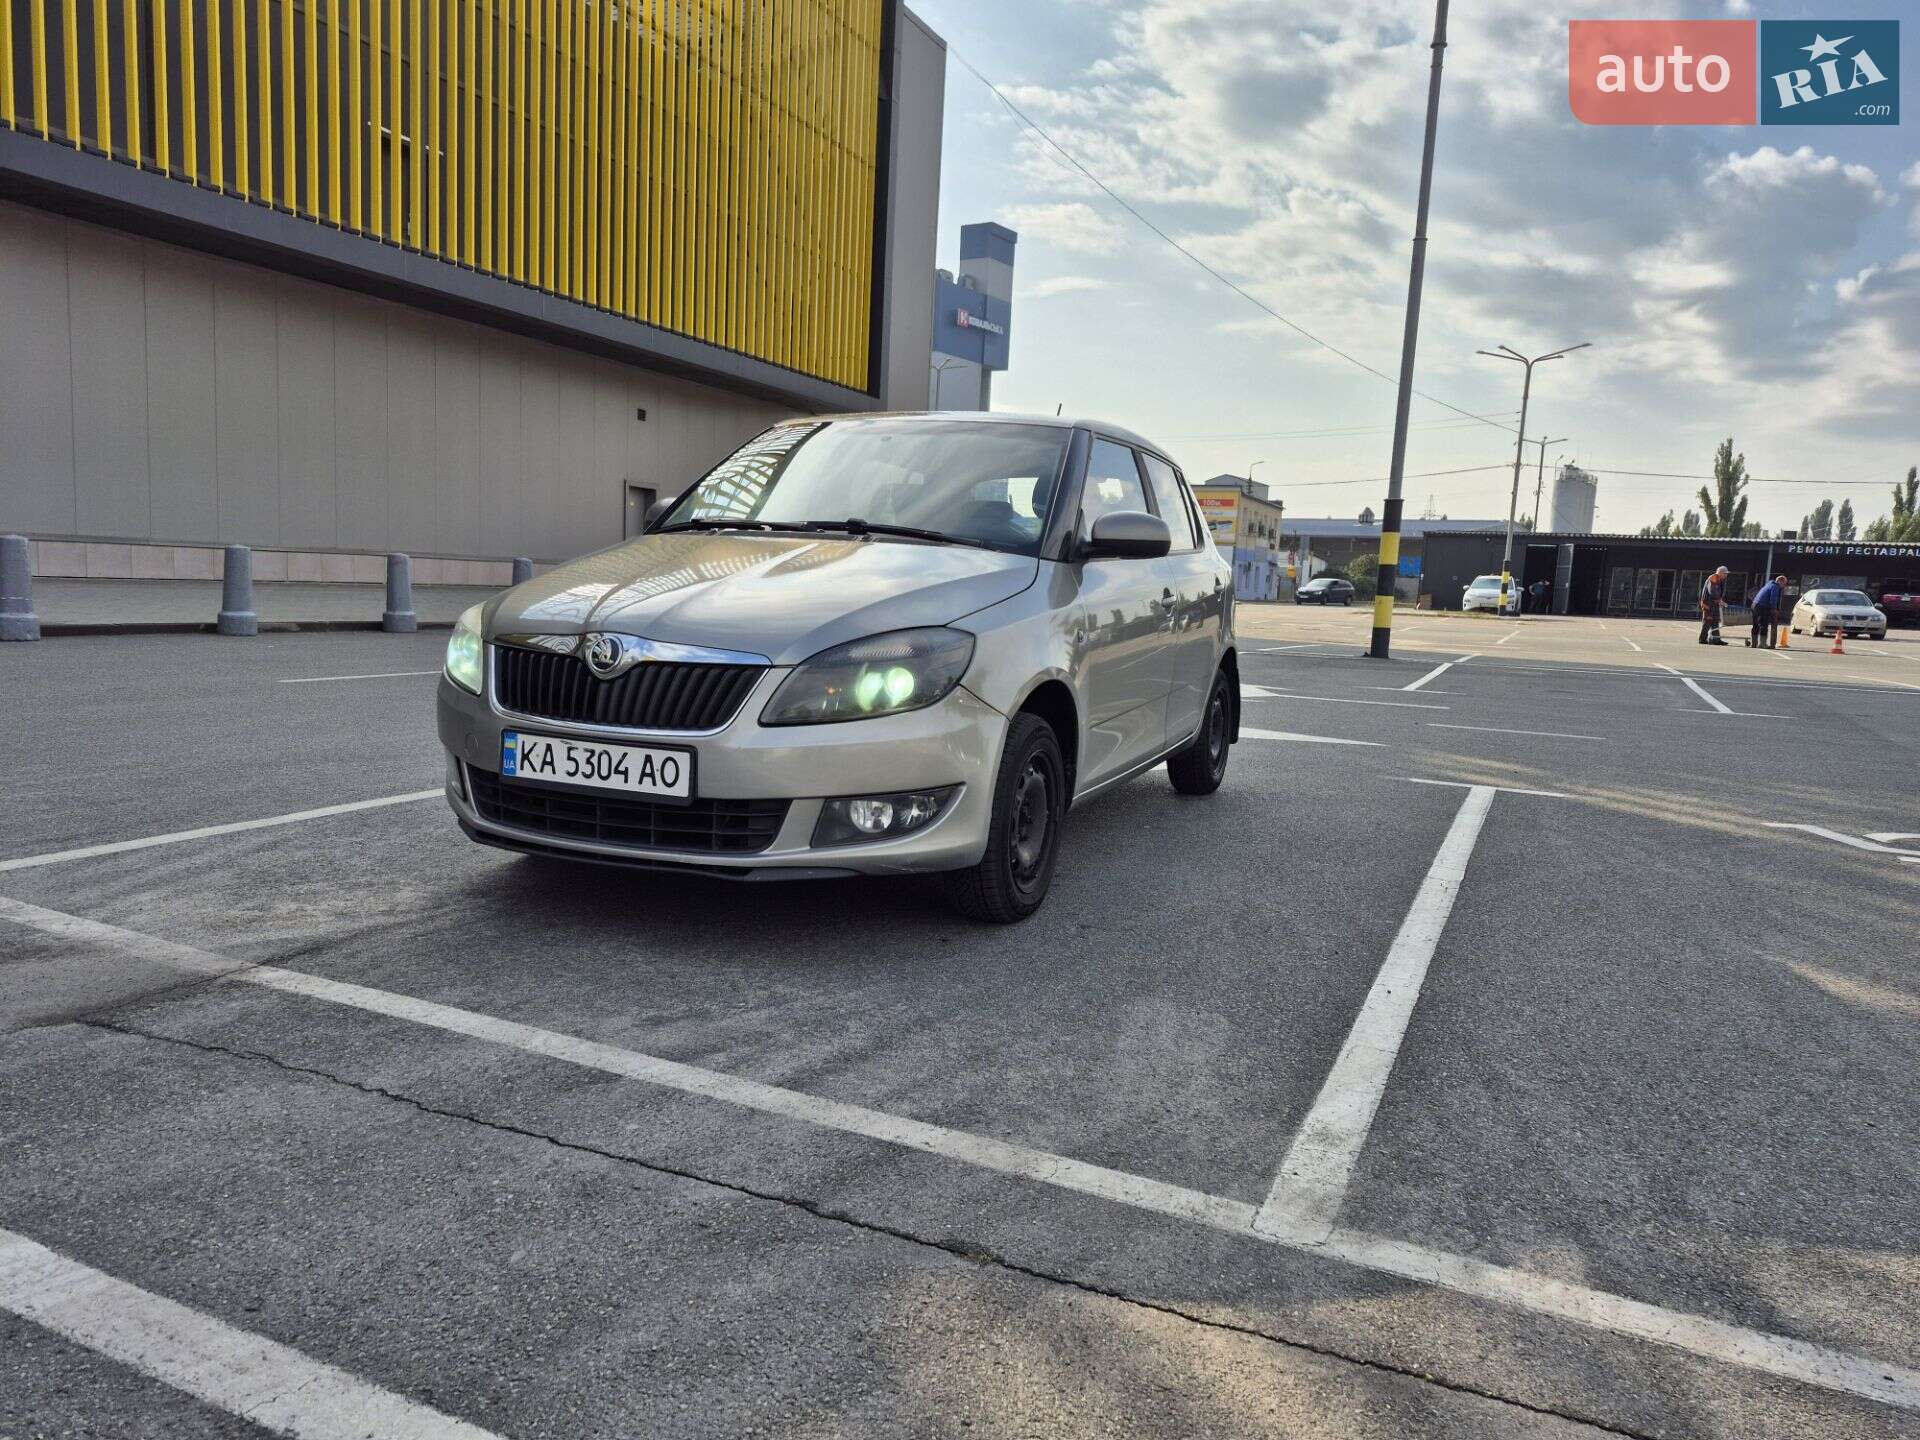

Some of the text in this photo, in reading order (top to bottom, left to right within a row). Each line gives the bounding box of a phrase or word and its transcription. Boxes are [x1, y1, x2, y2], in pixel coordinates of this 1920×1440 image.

[1788, 544, 1840, 554] РЕМОНТ
[504, 759, 516, 769] UA
[520, 740, 556, 775] KA
[565, 745, 629, 784] 5304
